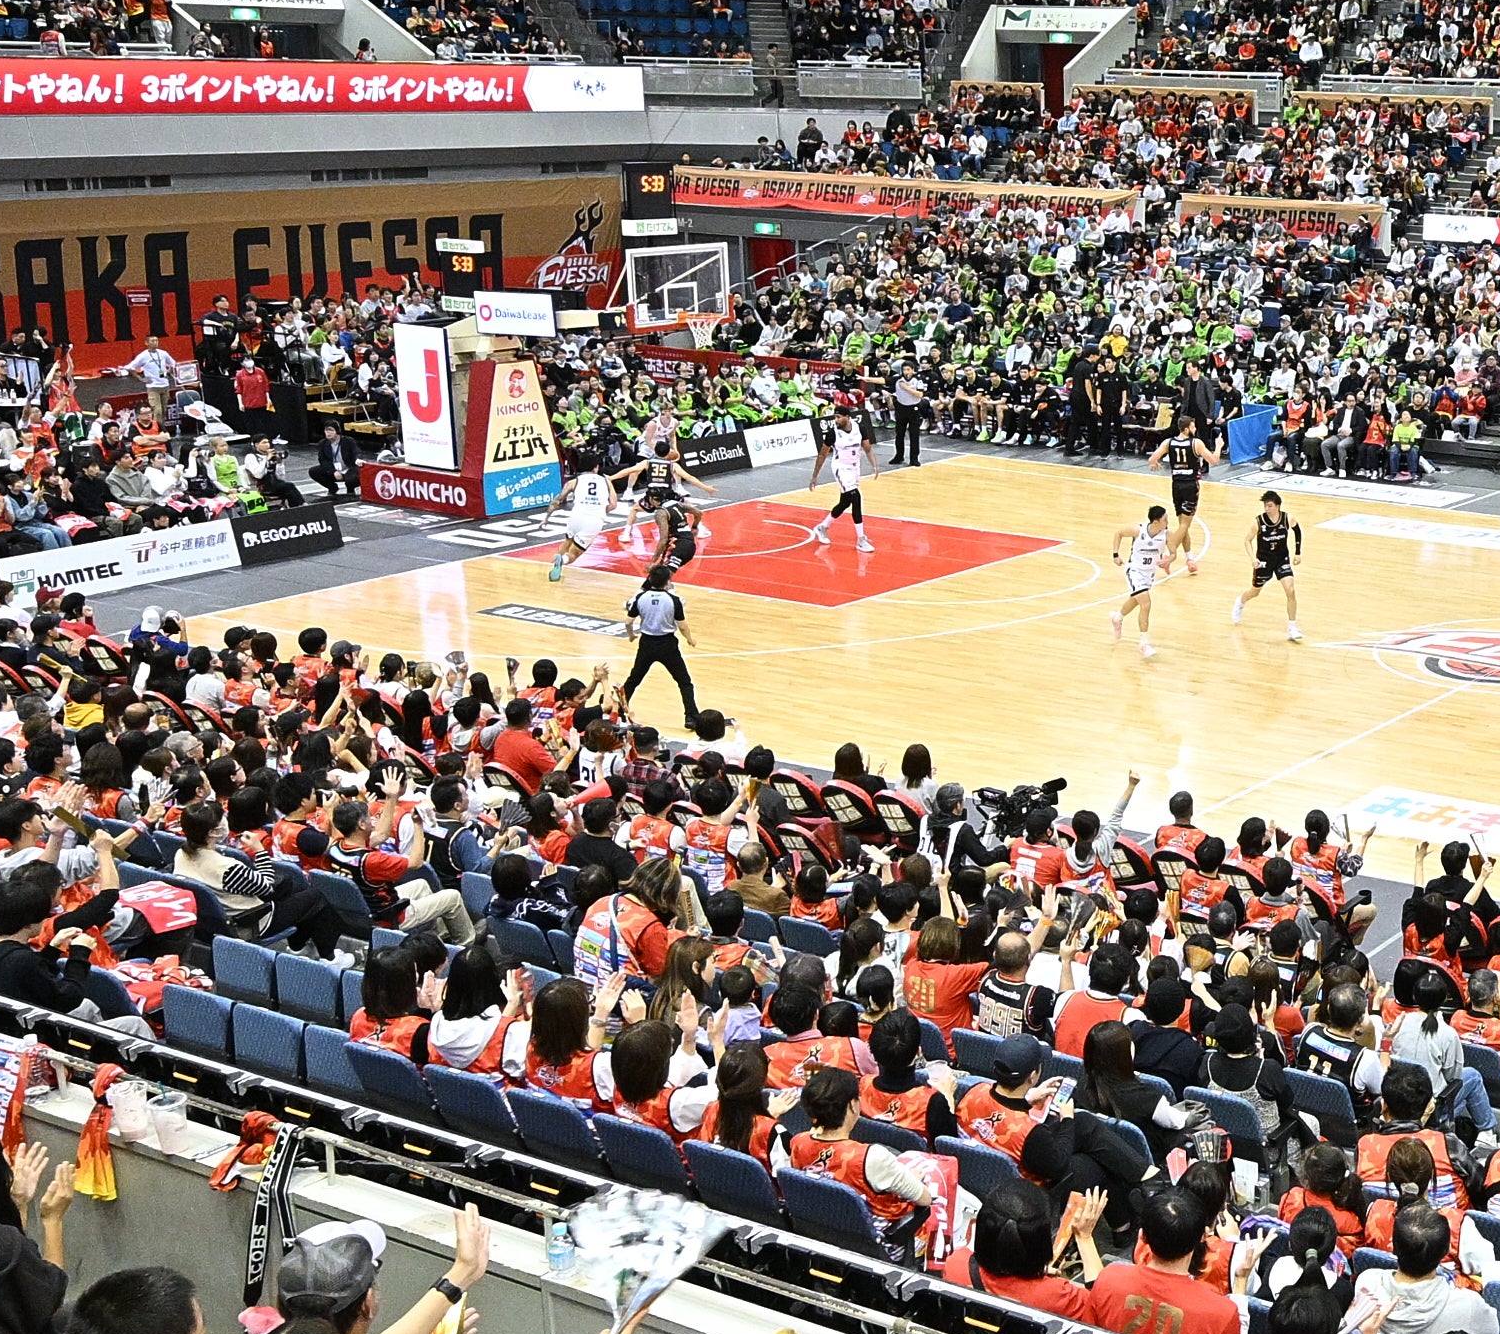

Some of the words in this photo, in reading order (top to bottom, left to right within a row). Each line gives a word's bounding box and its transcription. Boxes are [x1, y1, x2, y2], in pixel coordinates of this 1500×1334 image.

[641, 175, 664, 193] 5:33
[695, 178, 739, 198] EVESSA
[762, 180, 802, 198] OSAKA
[807, 183, 855, 204] EVESSA
[878, 186, 921, 207] OSAKA
[453, 255, 473, 273] 5:33
[567, 254, 594, 267] OSAKA
[536, 261, 611, 289] EVESSA
[406, 349, 443, 424] J
[496, 402, 539, 416] KINCHO
[503, 425, 535, 441] ゴキブリ
[763, 432, 808, 450] りそなグループ
[700, 443, 746, 464] SoftBank
[651, 463, 668, 477] 35
[396, 481, 467, 507] KINCHO
[588, 481, 597, 496] 2
[160, 530, 229, 556] 谷中運輸倉庫
[37, 562, 123, 592] HAMTEC
[907, 975, 936, 1013] 20
